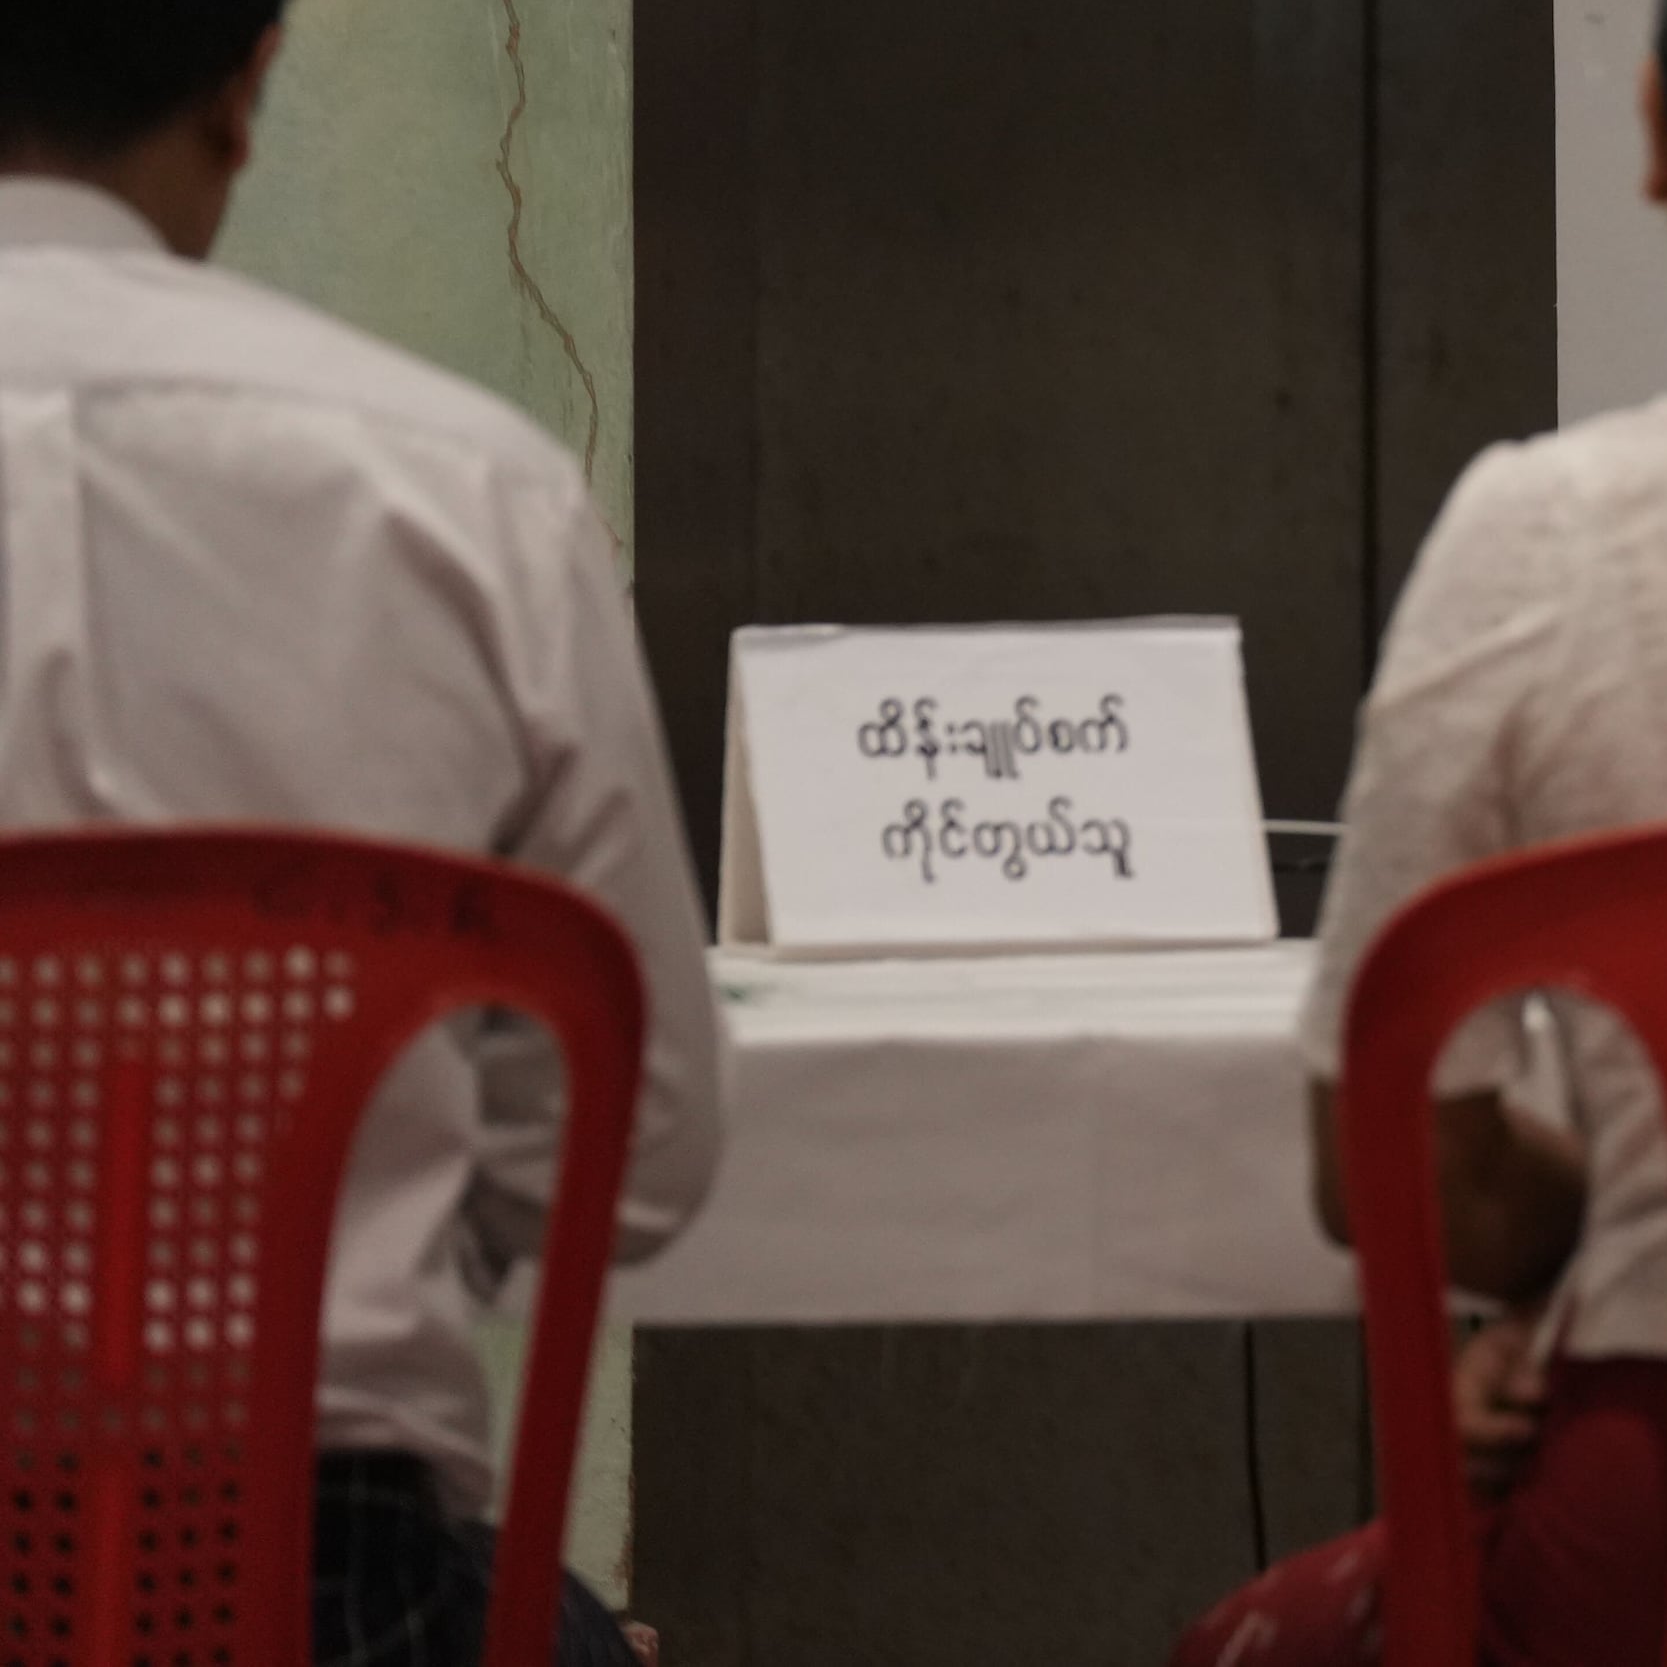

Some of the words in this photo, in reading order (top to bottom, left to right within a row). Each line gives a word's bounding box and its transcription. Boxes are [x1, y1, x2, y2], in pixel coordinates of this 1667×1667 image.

[881, 796, 1134, 883] ကိုင်တွယ်သူ
